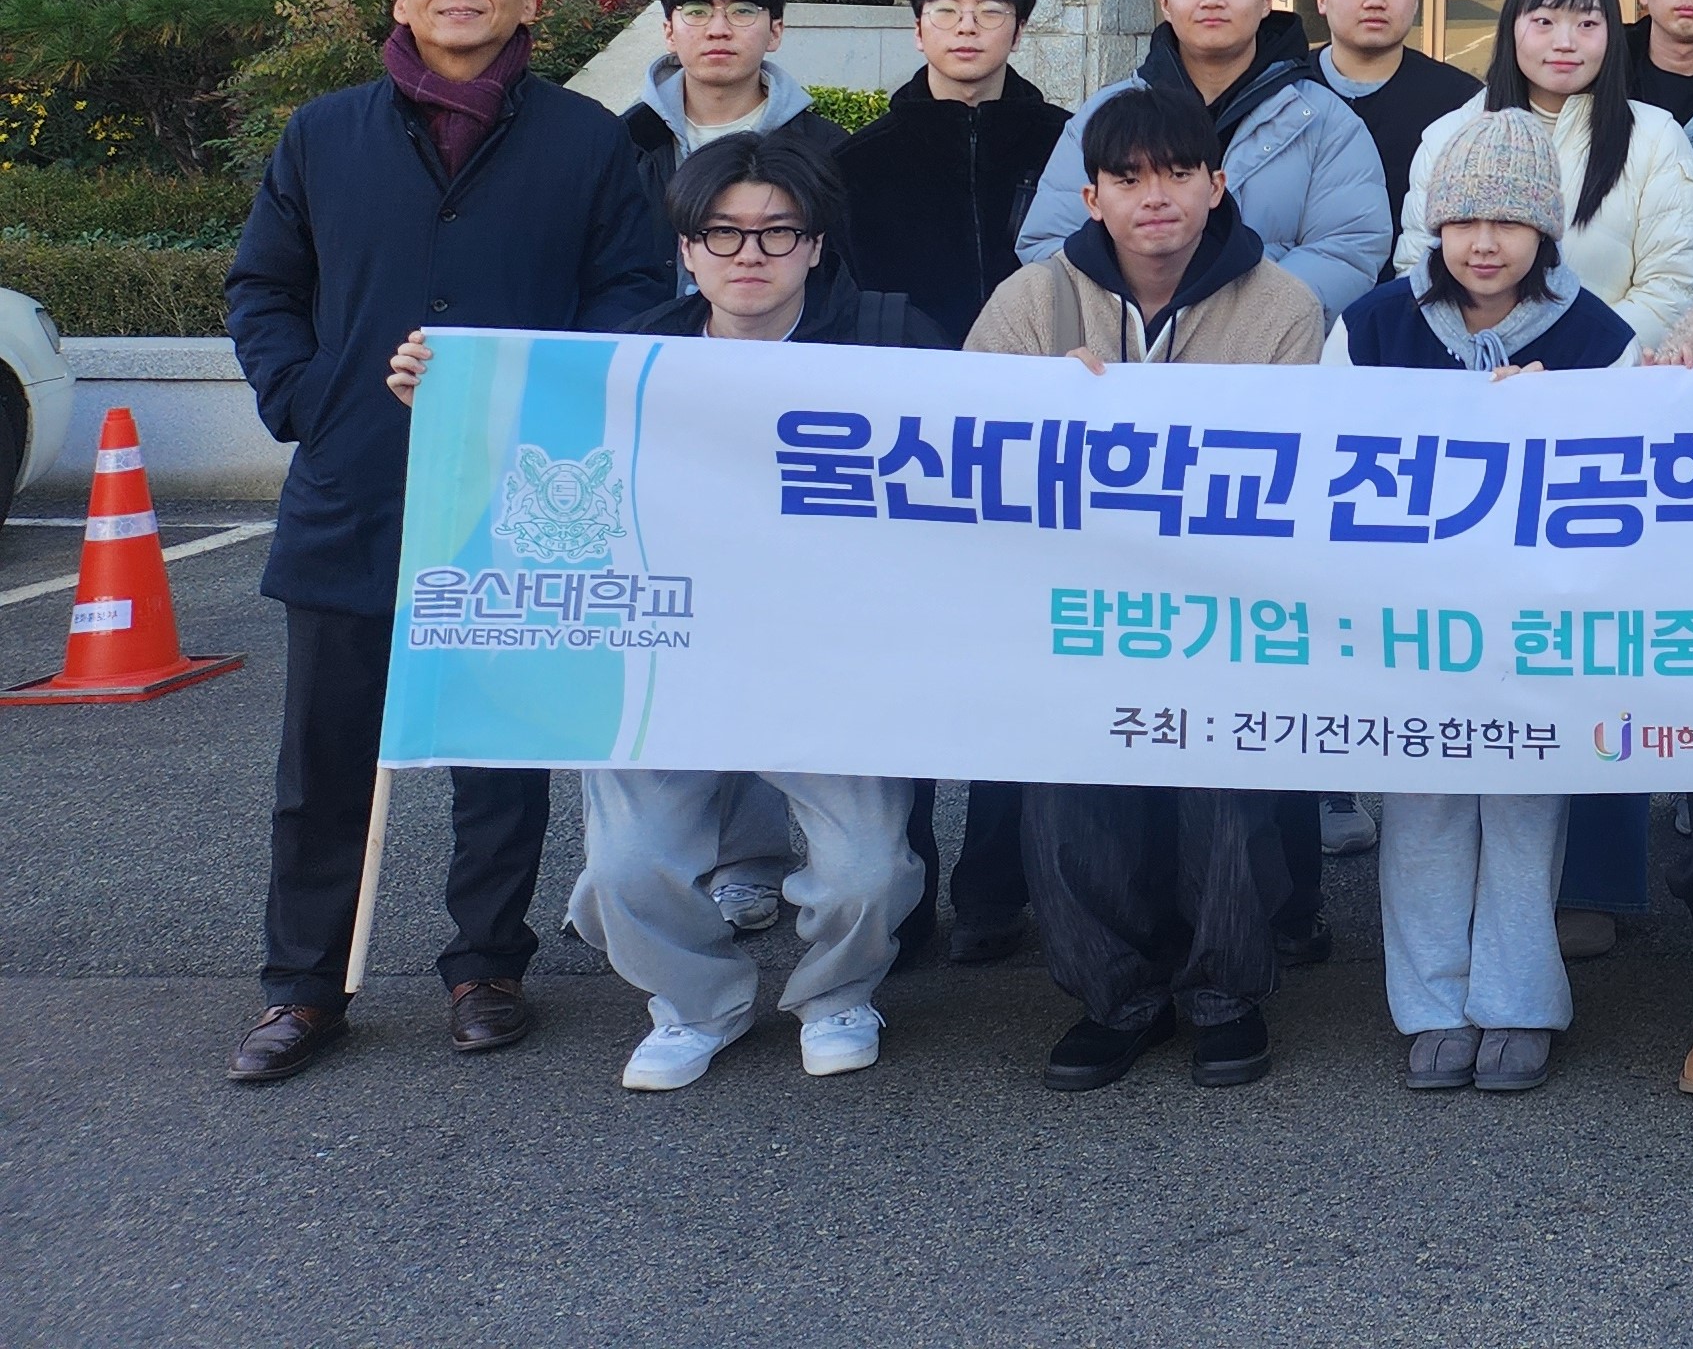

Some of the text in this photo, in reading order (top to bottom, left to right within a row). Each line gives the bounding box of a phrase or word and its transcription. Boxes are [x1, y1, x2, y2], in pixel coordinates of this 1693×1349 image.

[775, 410, 1303, 538] 울산대학교
[412, 569, 694, 623] 울산대학교
[411, 628, 690, 649] UNIVERSITY OF ULSAN
[1049, 587, 1311, 667] 탐방기업
[1337, 616, 1355, 659] :
[1380, 606, 1485, 675] HD
[1109, 706, 1189, 750] 주최
[1231, 710, 1562, 762] 전기전자융합학부
